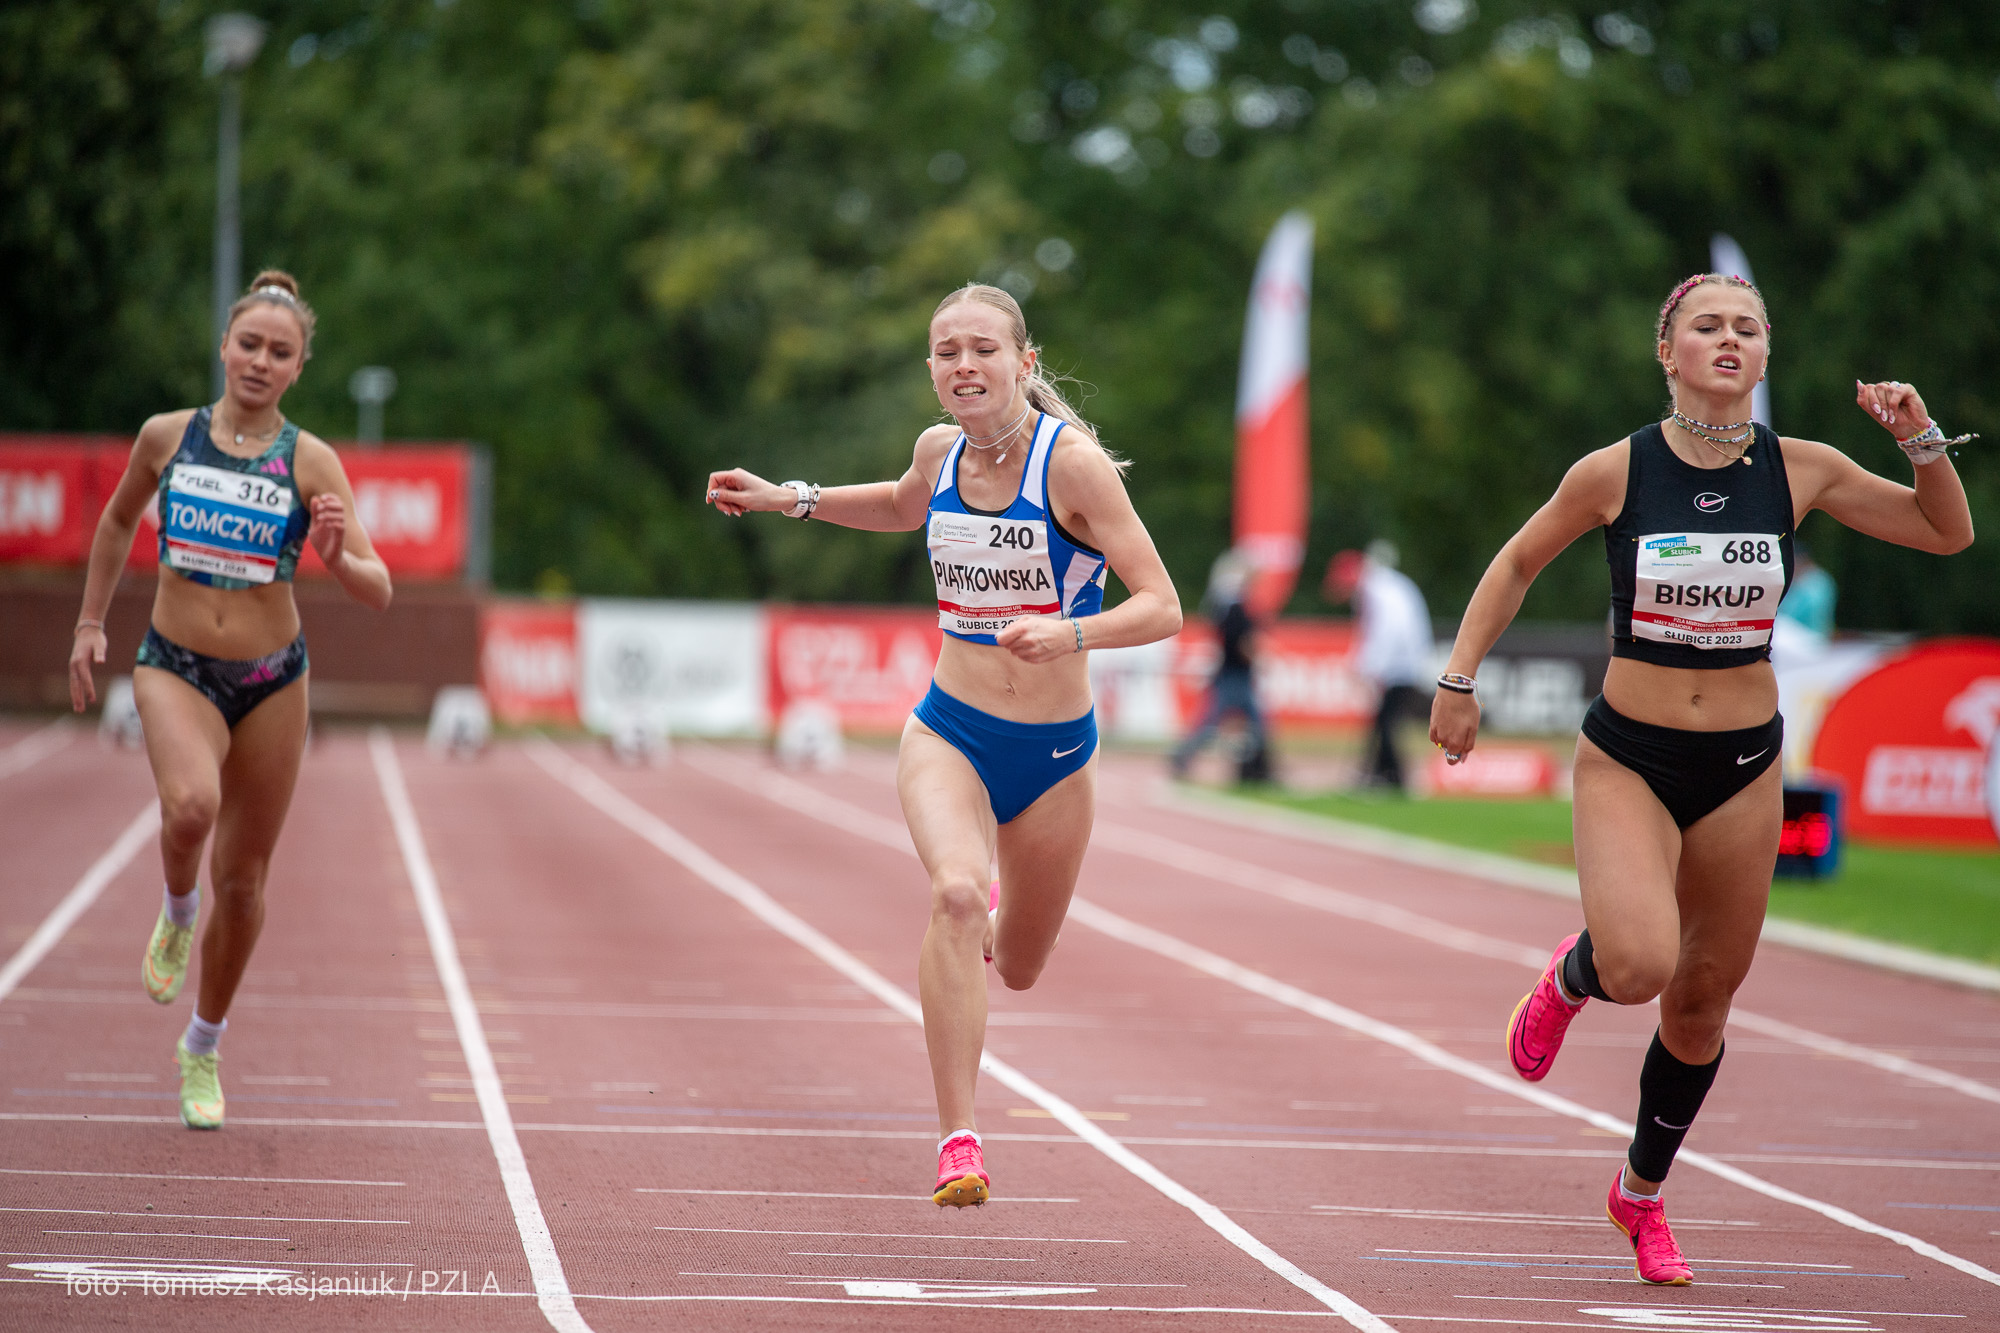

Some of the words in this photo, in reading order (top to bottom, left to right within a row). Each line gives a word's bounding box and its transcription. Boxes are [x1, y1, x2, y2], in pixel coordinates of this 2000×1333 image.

[237, 481, 280, 507] 316
[170, 502, 278, 547] TOMCZYK
[988, 524, 1034, 550] 240
[1721, 540, 1771, 564] 688
[934, 560, 1051, 594] PIĄTKOWSKA
[1655, 584, 1765, 608] BISKUP
[957, 620, 999, 630] SŁUBICE
[1664, 630, 1712, 644] SŁUBICE
[1714, 635, 1742, 644] 2023
